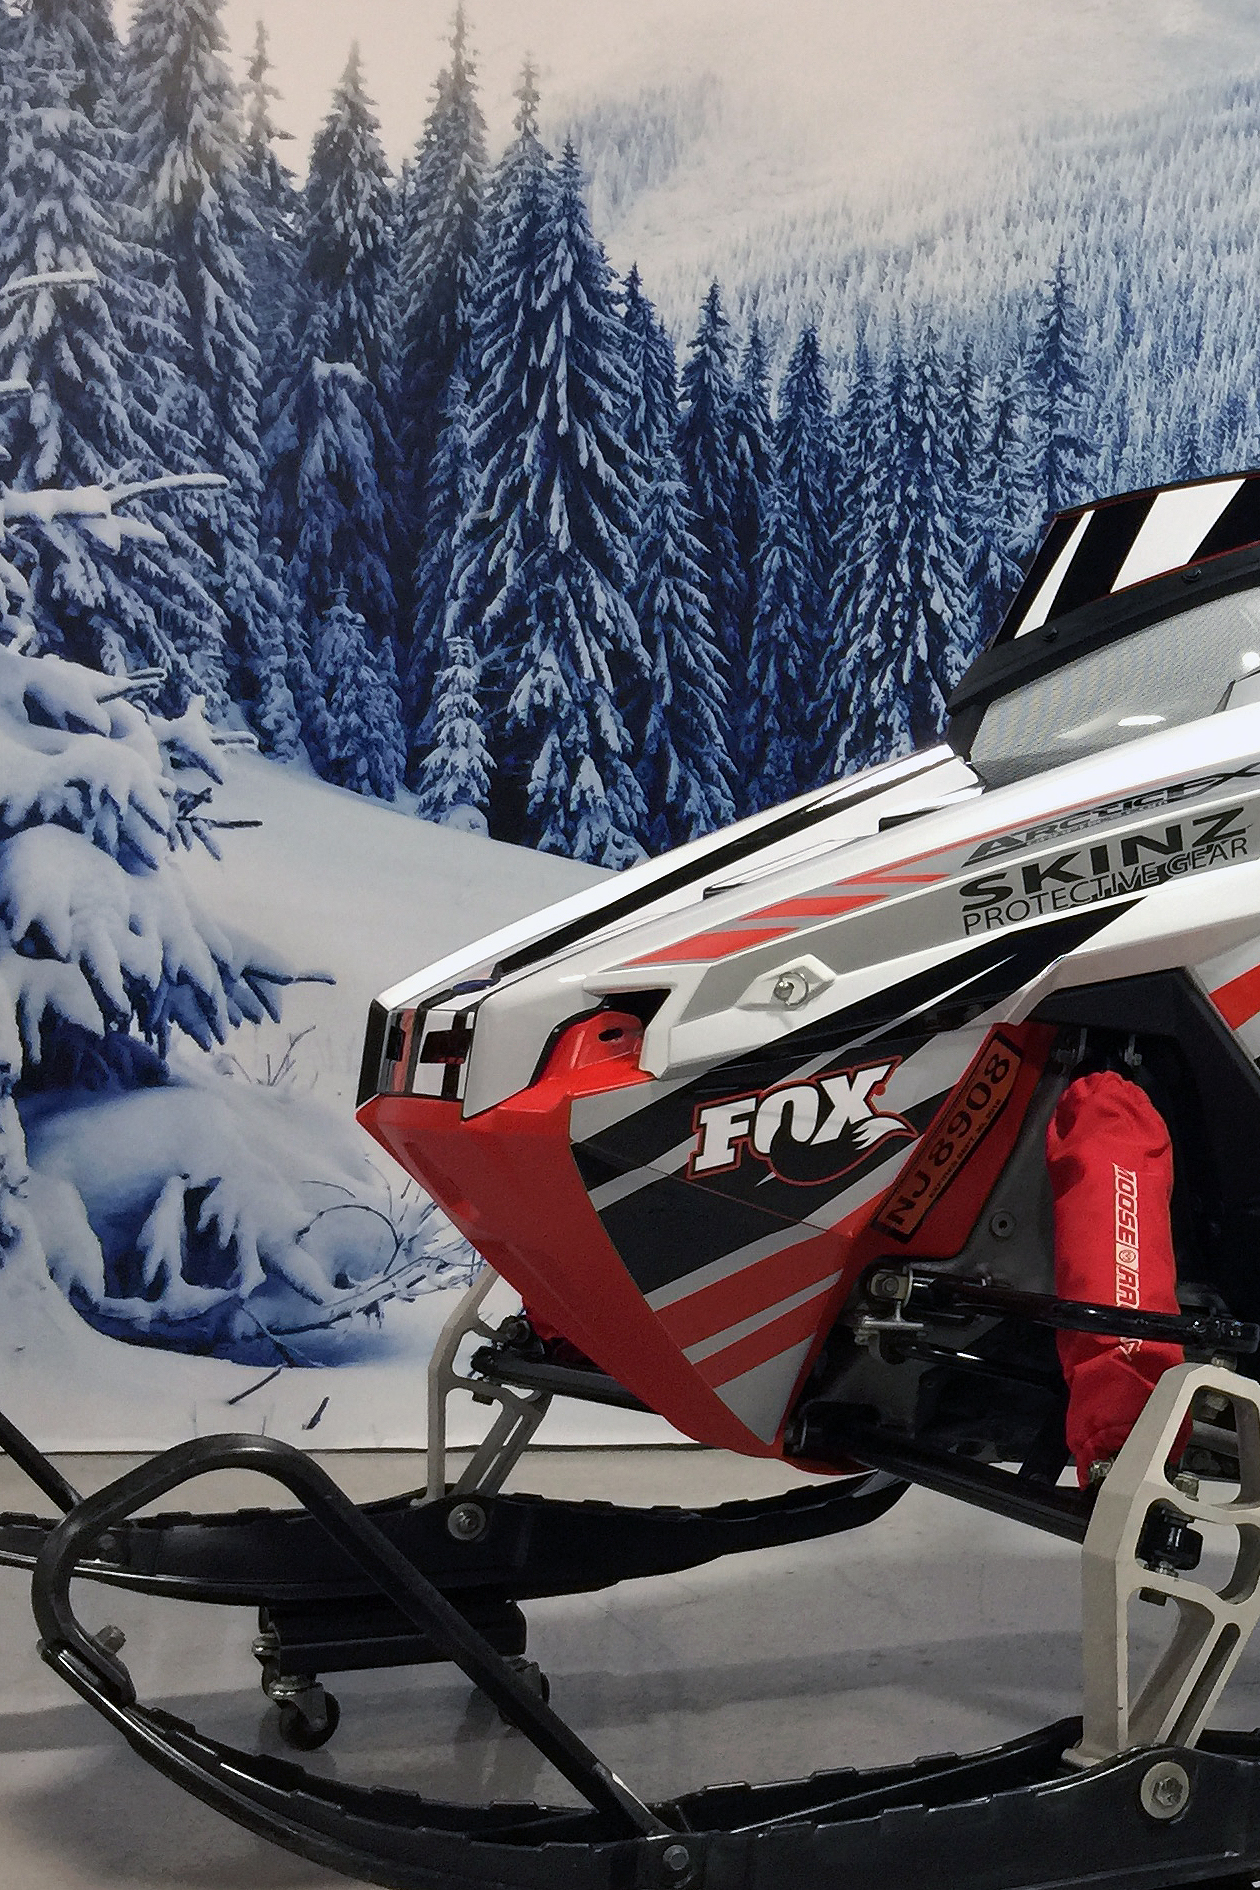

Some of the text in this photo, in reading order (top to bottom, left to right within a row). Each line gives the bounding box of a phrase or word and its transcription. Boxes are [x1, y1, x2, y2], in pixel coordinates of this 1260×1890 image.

[959, 807, 1250, 911] SKINZ
[962, 836, 1249, 936] PROTECTIVE GEAR
[690, 1058, 900, 1176] FOX
[886, 1053, 1010, 1227] NJ 8908
